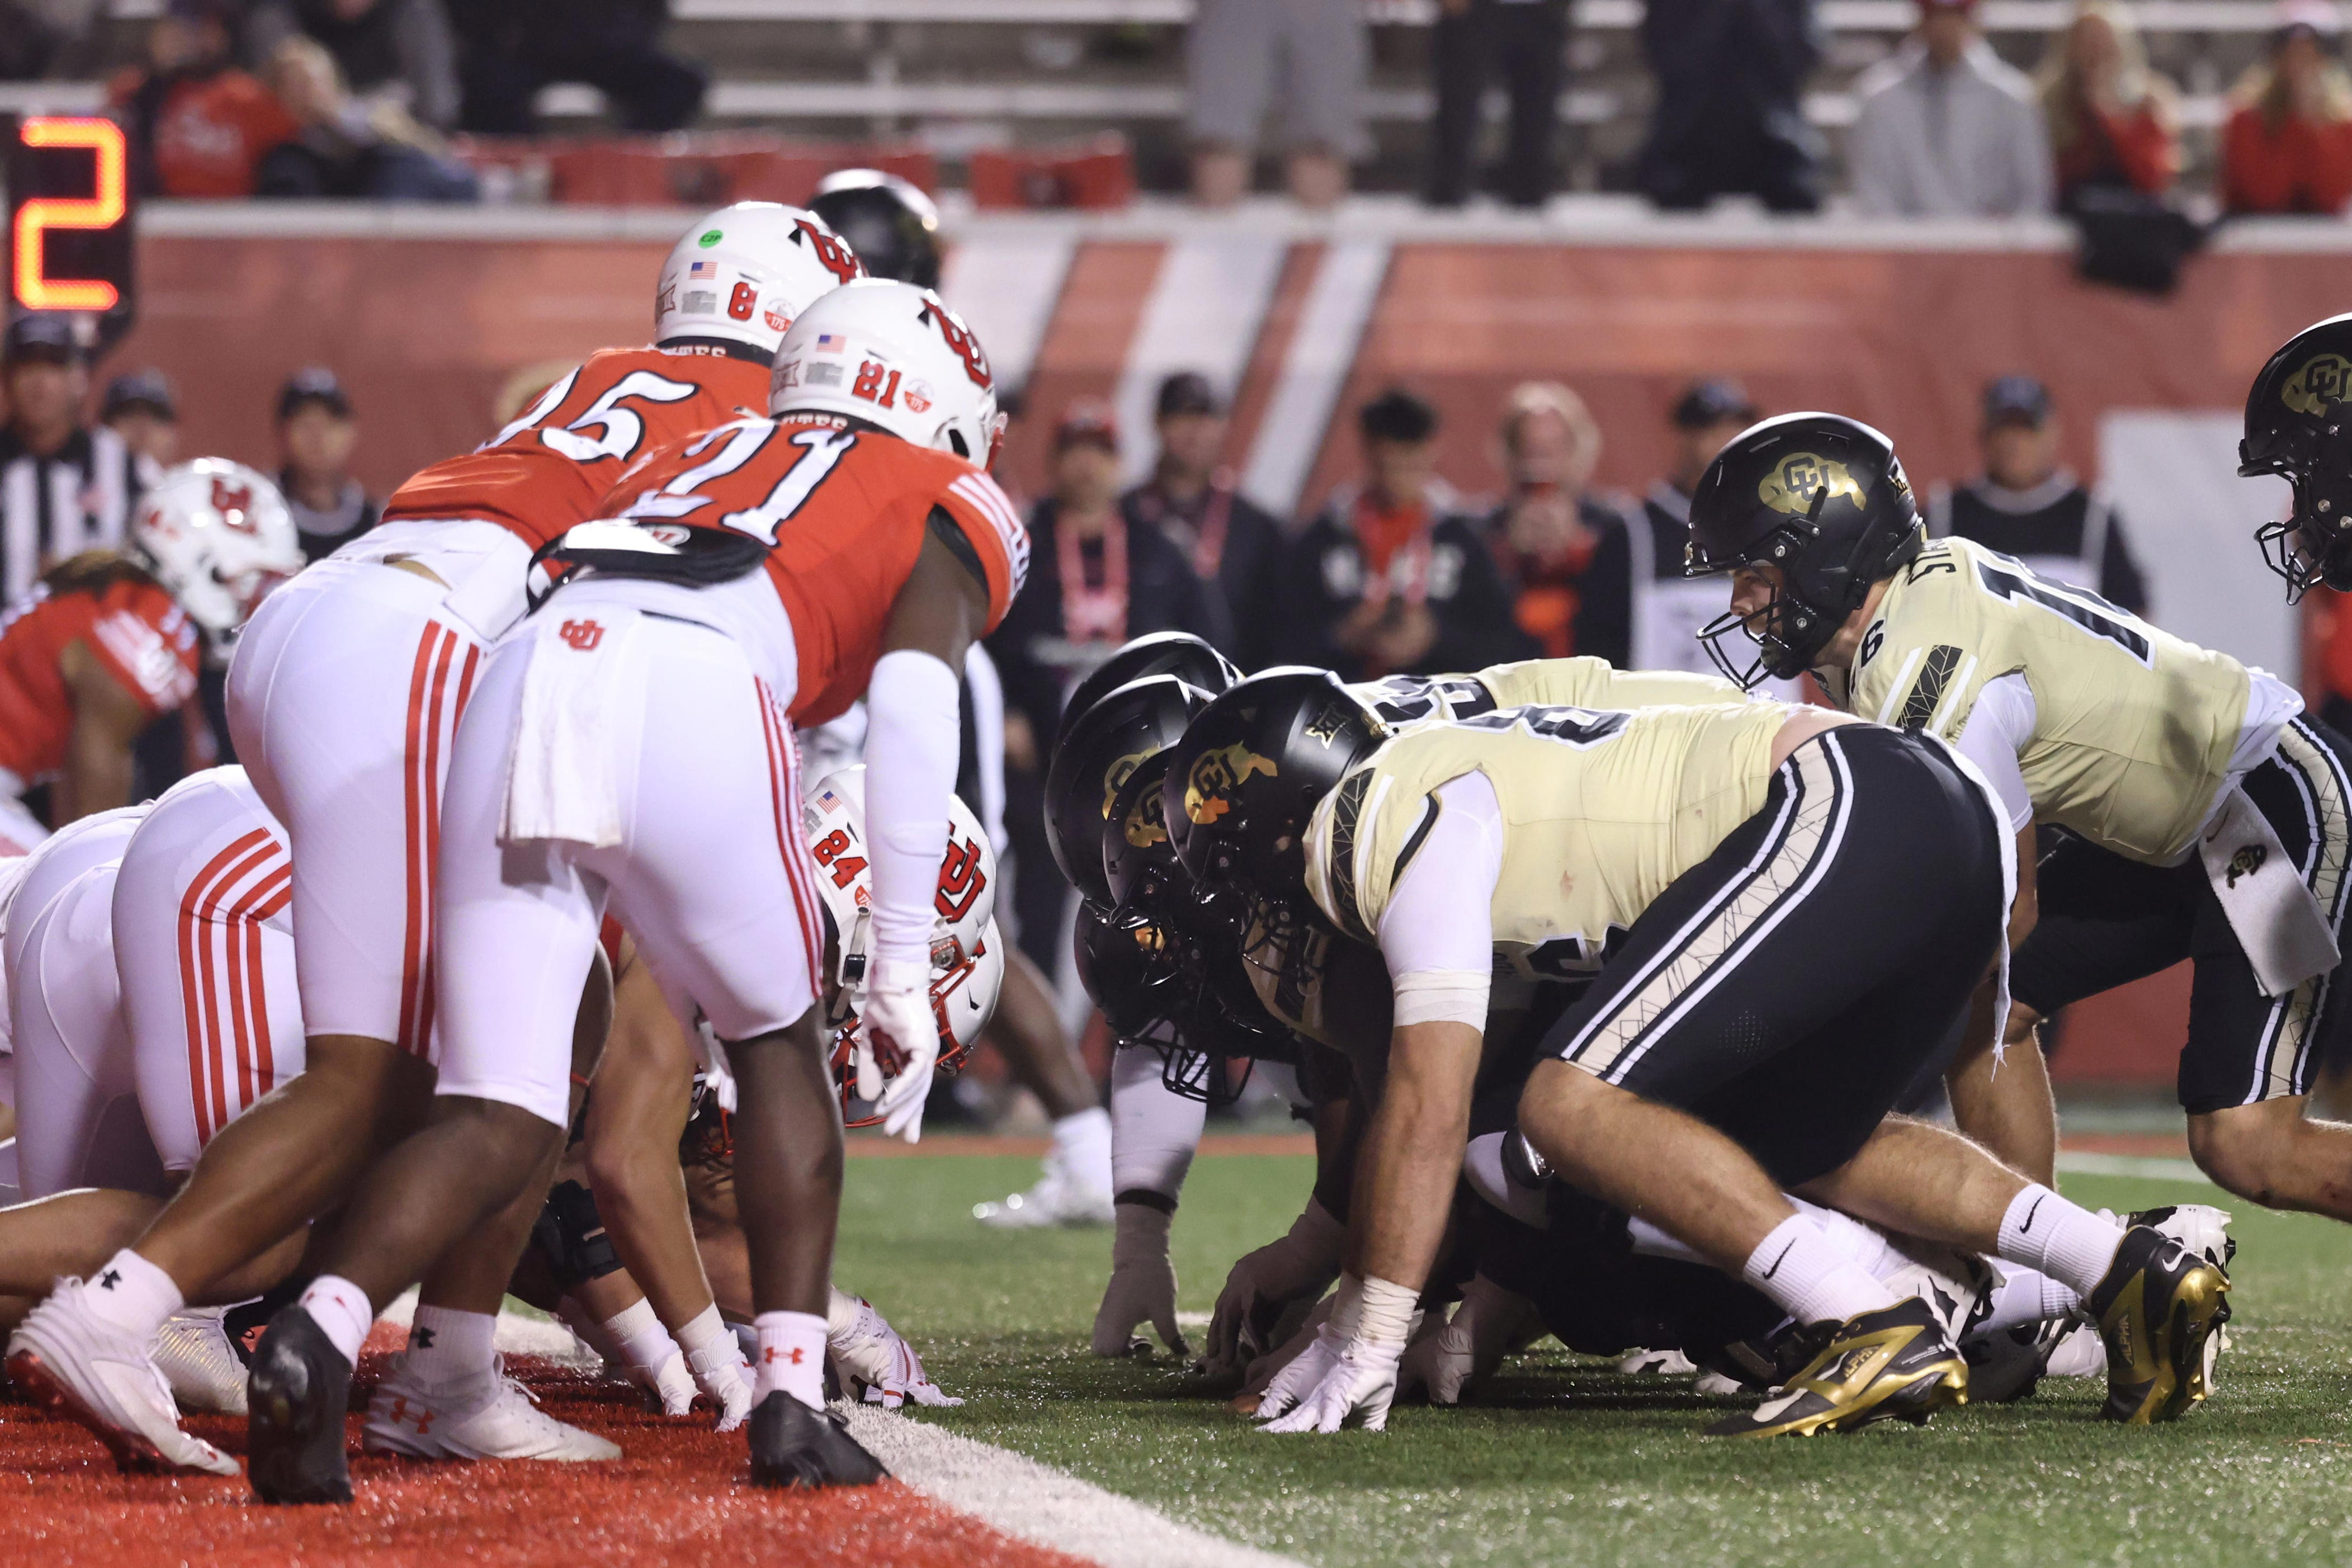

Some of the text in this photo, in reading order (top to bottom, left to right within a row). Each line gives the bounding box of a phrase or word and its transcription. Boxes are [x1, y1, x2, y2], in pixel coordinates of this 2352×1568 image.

[13, 116, 126, 310] 2
[852, 359, 902, 410] 21
[617, 417, 858, 548] 21
[1783, 456, 1830, 502] CU
[813, 829, 869, 890] 24
